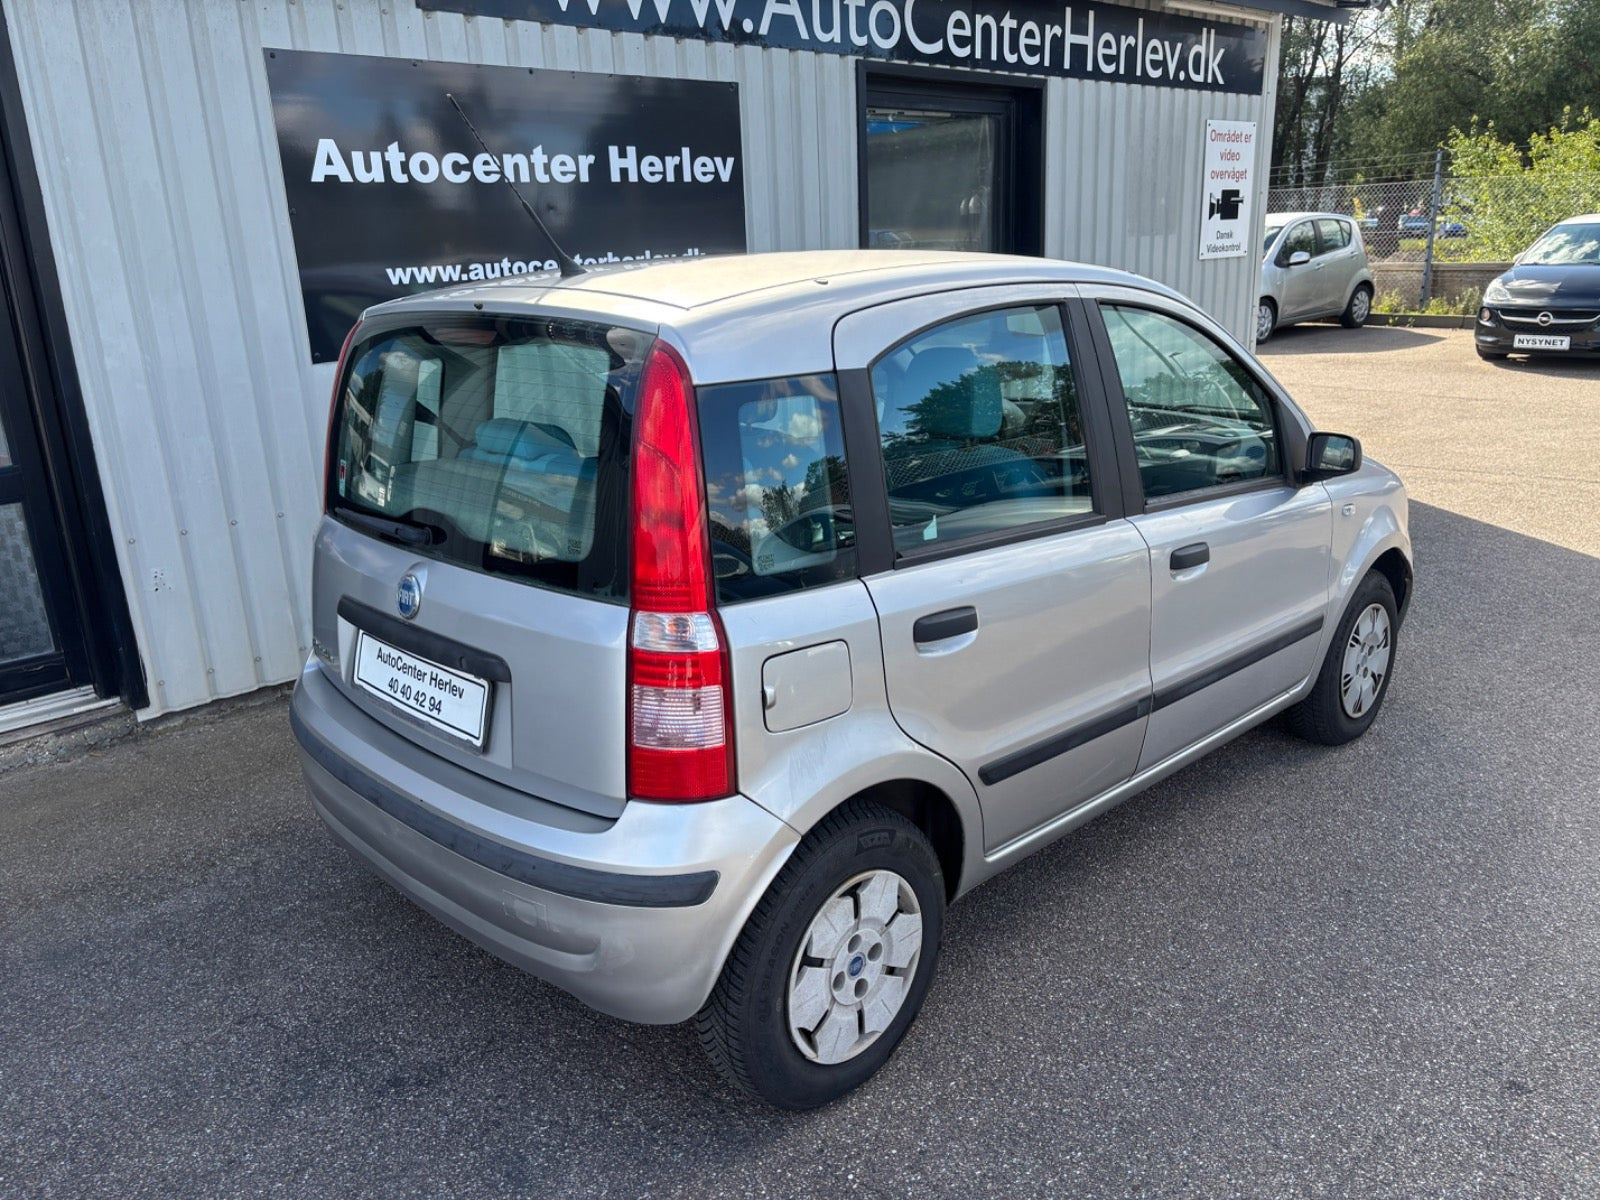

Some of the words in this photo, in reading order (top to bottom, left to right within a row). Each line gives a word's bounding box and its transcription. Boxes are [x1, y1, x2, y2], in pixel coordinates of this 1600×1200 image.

[1210, 129, 1243, 143] Området
[1244, 133, 1252, 143] er
[311, 138, 596, 184] Autocenter
[608, 145, 735, 184] Herlev
[1220, 148, 1240, 161] video
[1210, 168, 1247, 182] overvåget
[1216, 230, 1233, 240] Dansk
[1207, 242, 1241, 254] Videokontrol
[1517, 338, 1566, 346] NYSYNET
[376, 646, 428, 683] AutoCenter
[429, 670, 465, 700] Herlev
[387, 676, 399, 693] 40
[400, 681, 412, 700] 40
[413, 688, 426, 709] 42
[428, 695, 442, 716] 94
